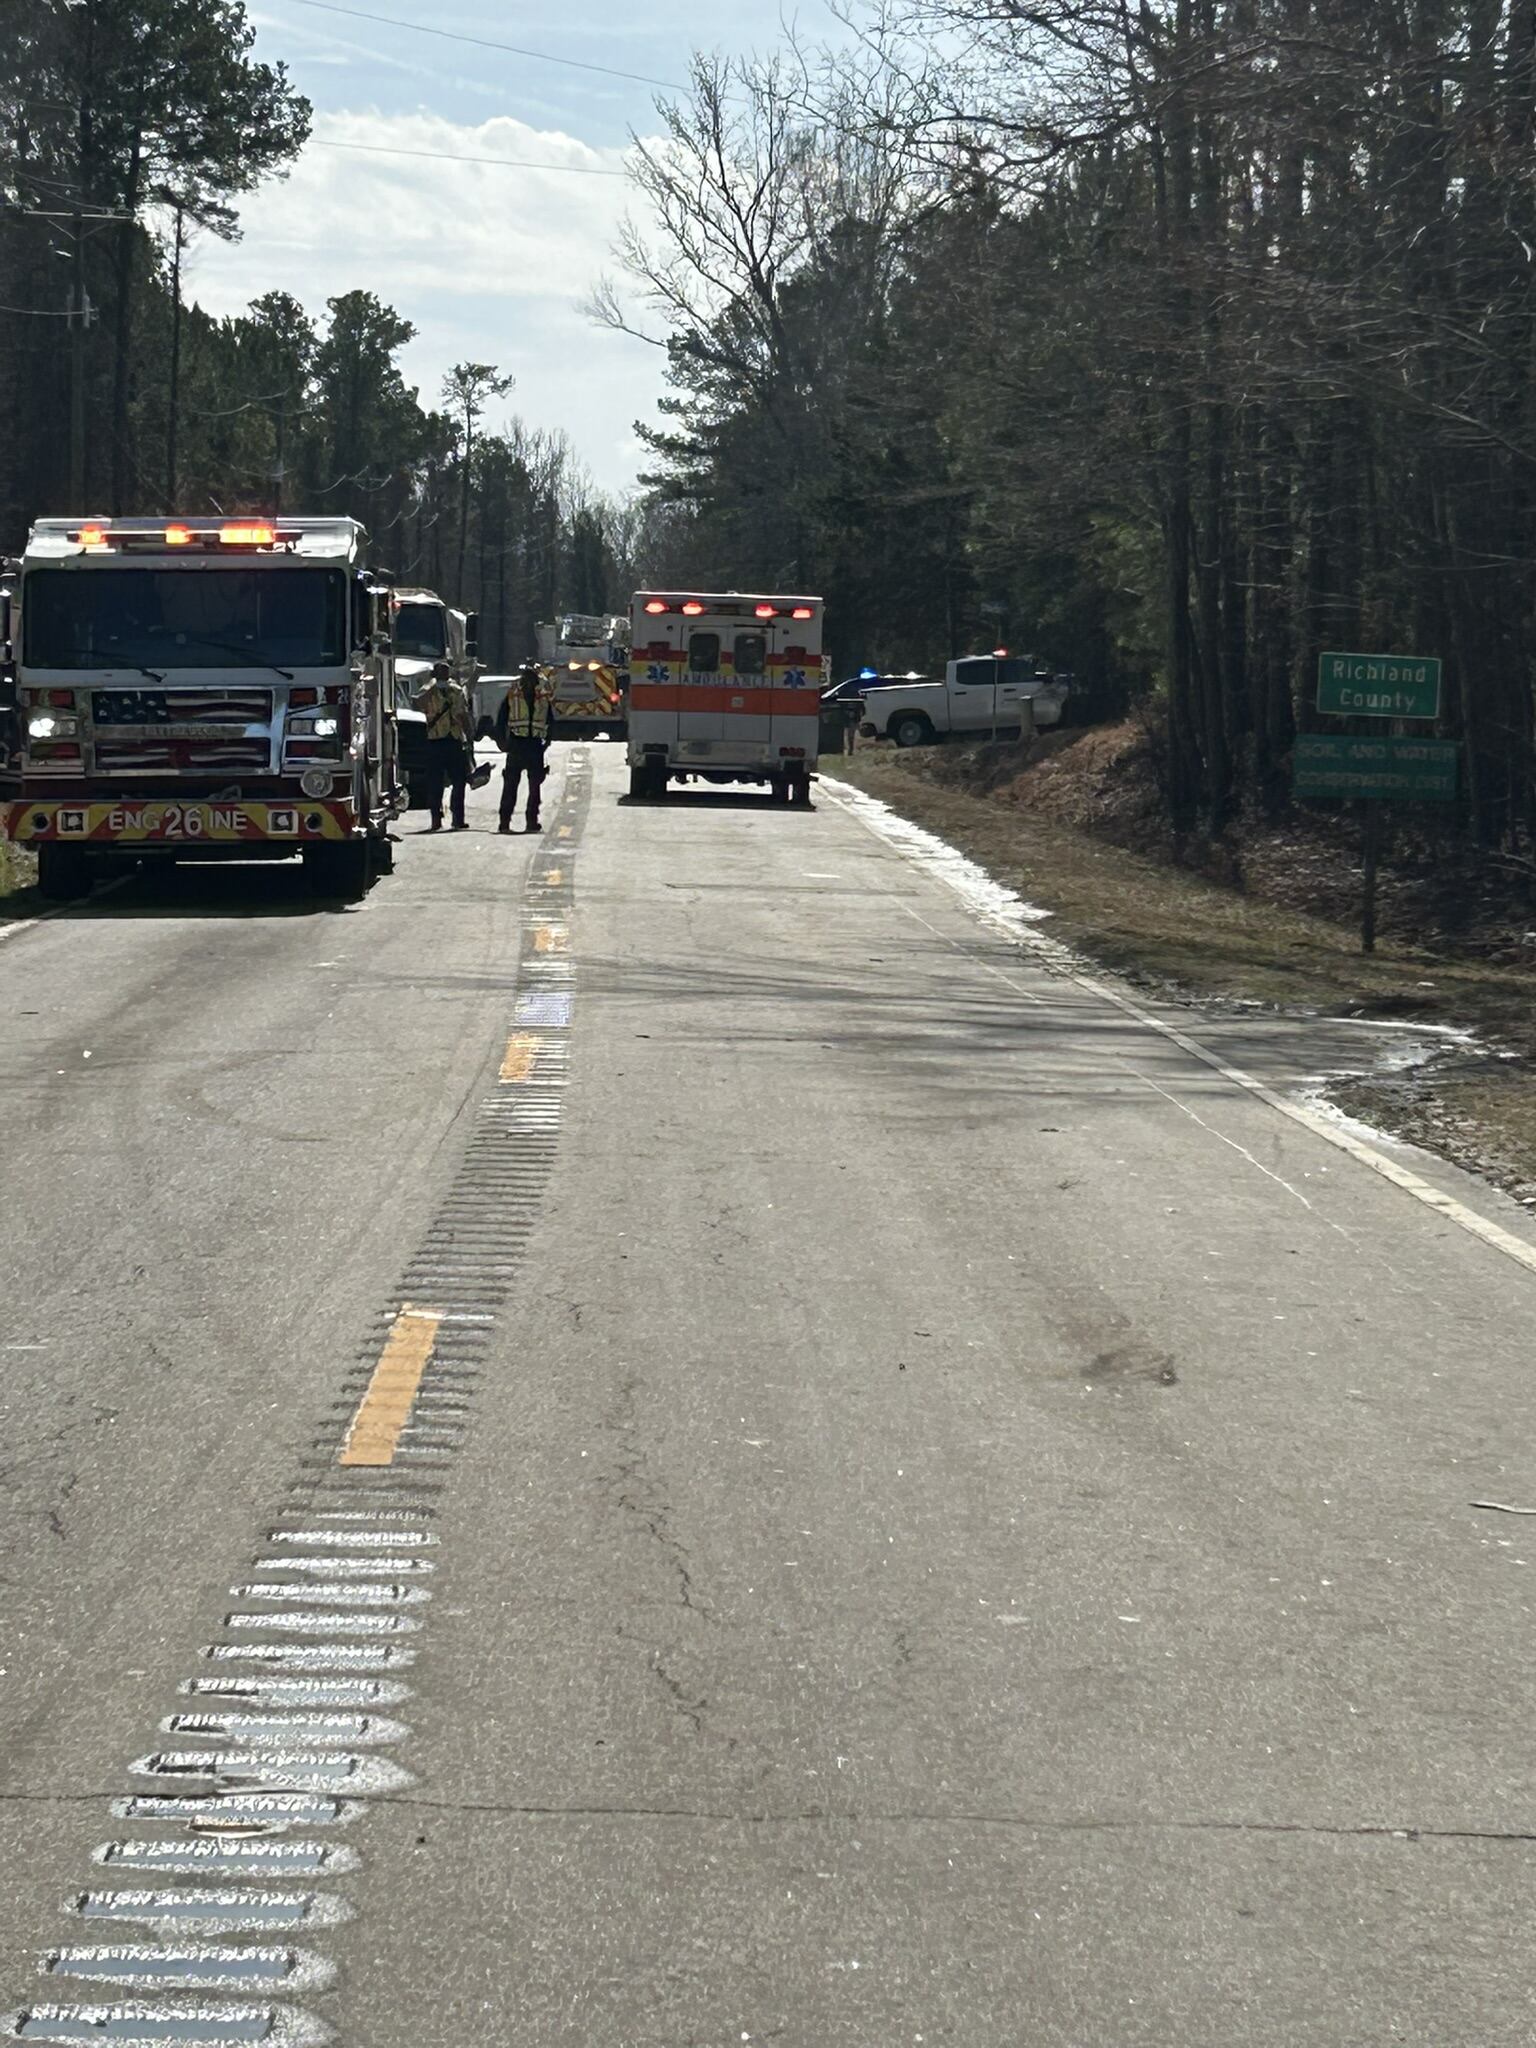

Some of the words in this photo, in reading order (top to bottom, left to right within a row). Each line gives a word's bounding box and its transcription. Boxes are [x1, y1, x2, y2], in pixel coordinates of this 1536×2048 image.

[1333, 660, 1426, 683] Richland
[1340, 688, 1416, 713] County
[108, 810, 160, 830] ENG
[164, 806, 203, 836] 26
[209, 810, 248, 830] INE
